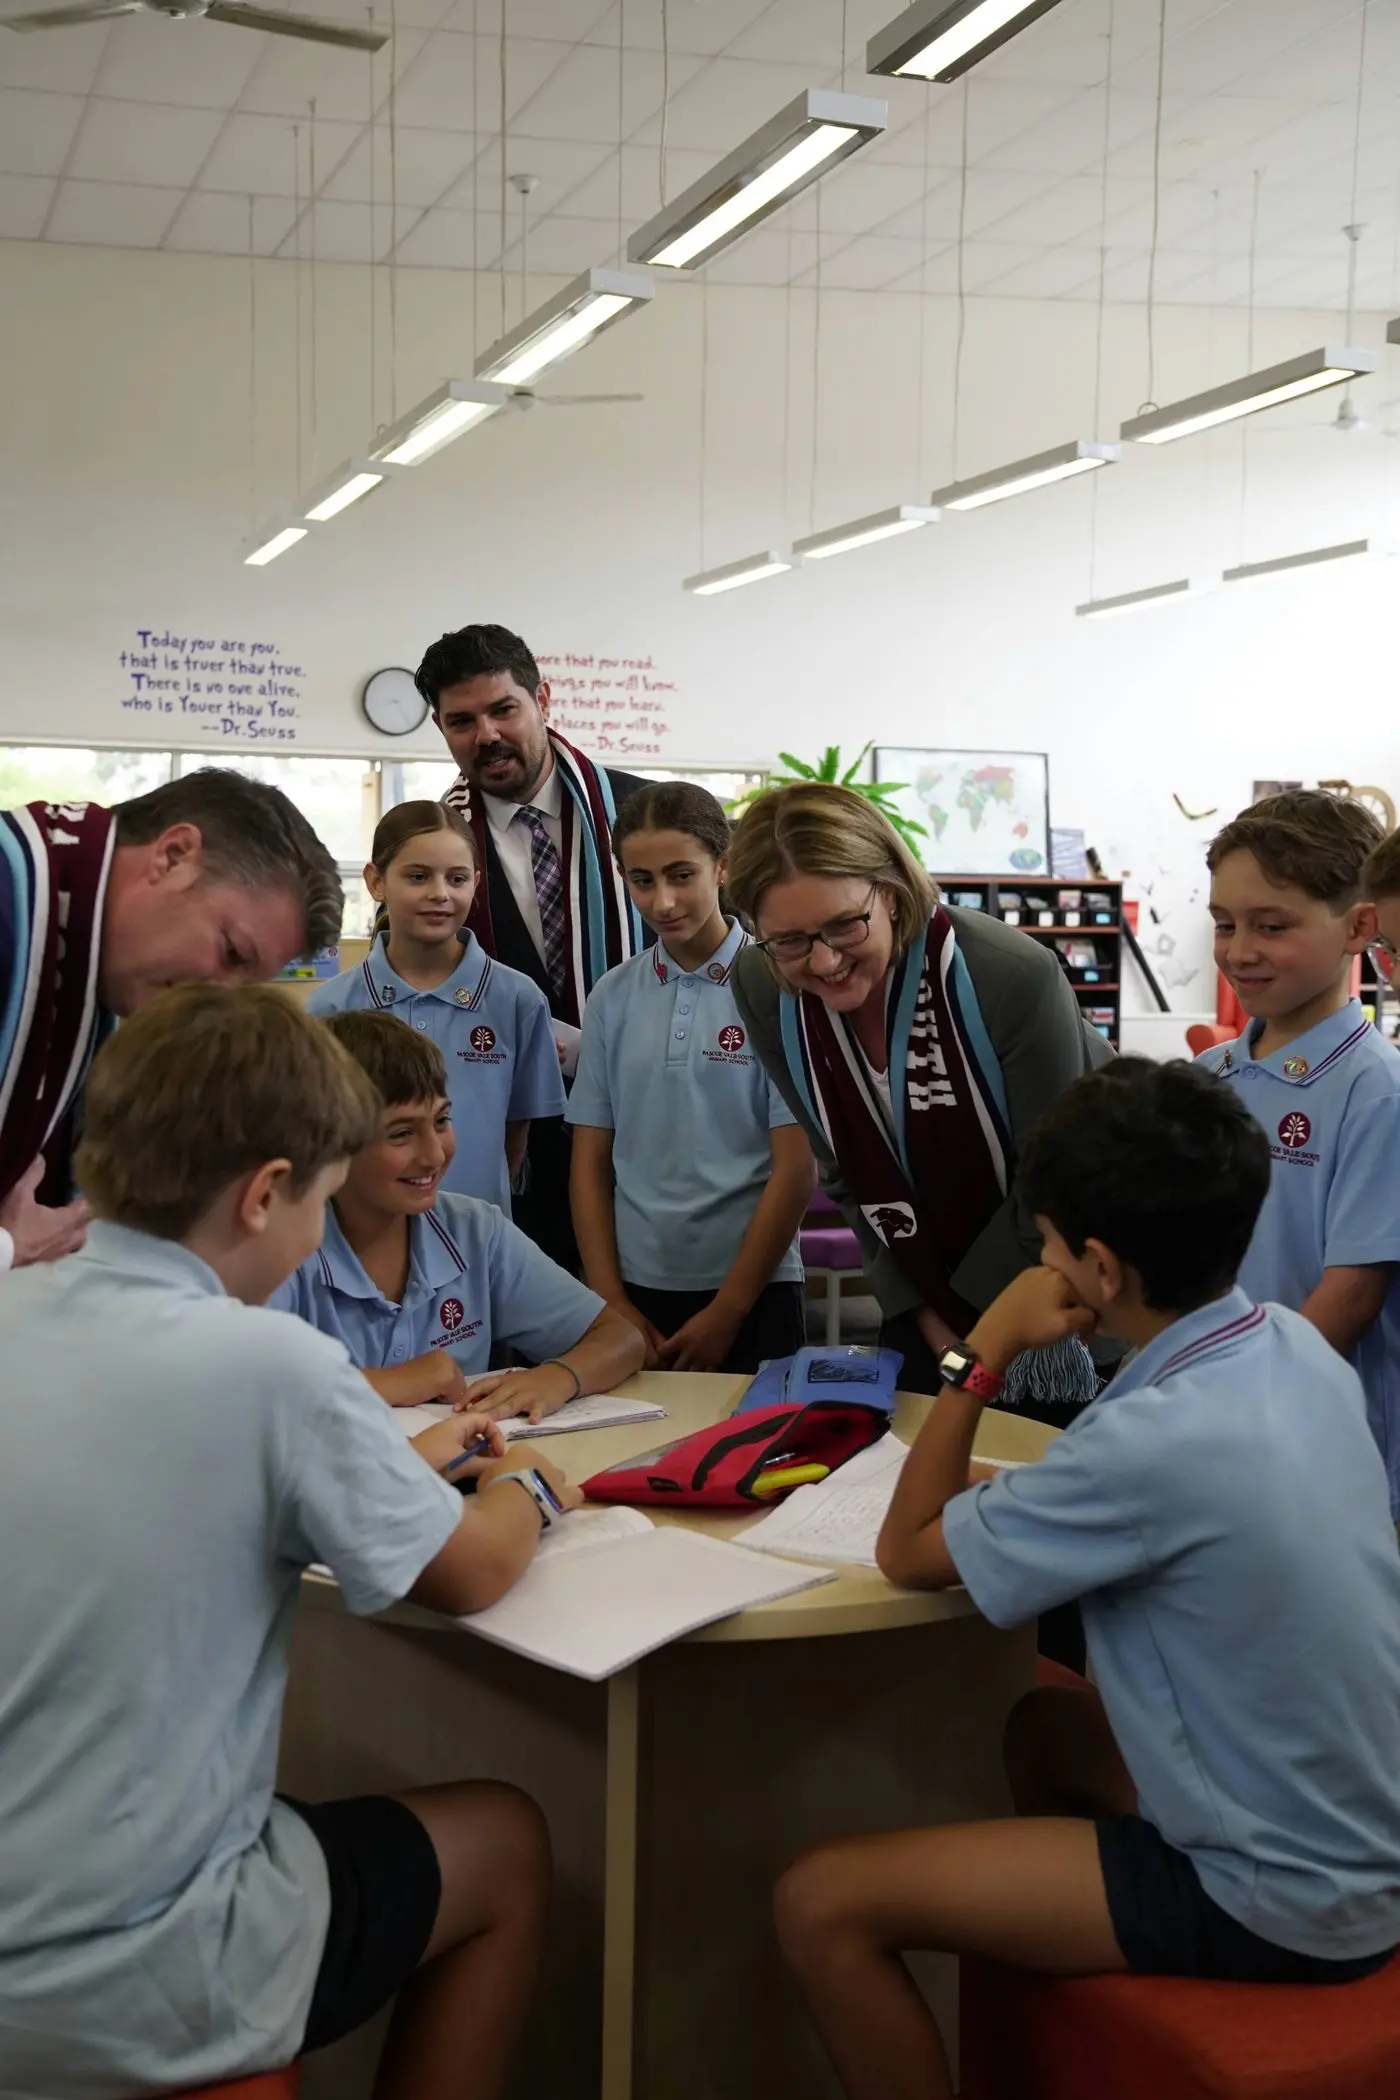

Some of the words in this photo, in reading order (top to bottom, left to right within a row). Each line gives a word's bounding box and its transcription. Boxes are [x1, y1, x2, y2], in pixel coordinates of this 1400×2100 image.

[136, 630, 187, 653] Today
[191, 638, 215, 653] you
[220, 640, 246, 653] are
[119, 651, 157, 670] that
[164, 654, 179, 670] is
[184, 654, 225, 673] truer
[230, 658, 265, 677] than
[565, 652, 594, 668] that
[598, 658, 619, 671] you
[130, 672, 181, 691] There
[186, 677, 201, 693] is
[206, 682, 223, 695] no
[228, 683, 253, 696] one
[590, 680, 612, 692] you
[615, 674, 639, 691] will
[121, 695, 152, 711] who
[158, 696, 173, 713] is
[178, 694, 223, 714] Youer
[227, 700, 263, 717] than
[571, 695, 601, 710] that
[604, 700, 626, 713] you
[552, 713, 597, 732] places
[600, 720, 622, 734] you
[625, 716, 649, 732] will
[461, 1320, 483, 1332] SOUTH
